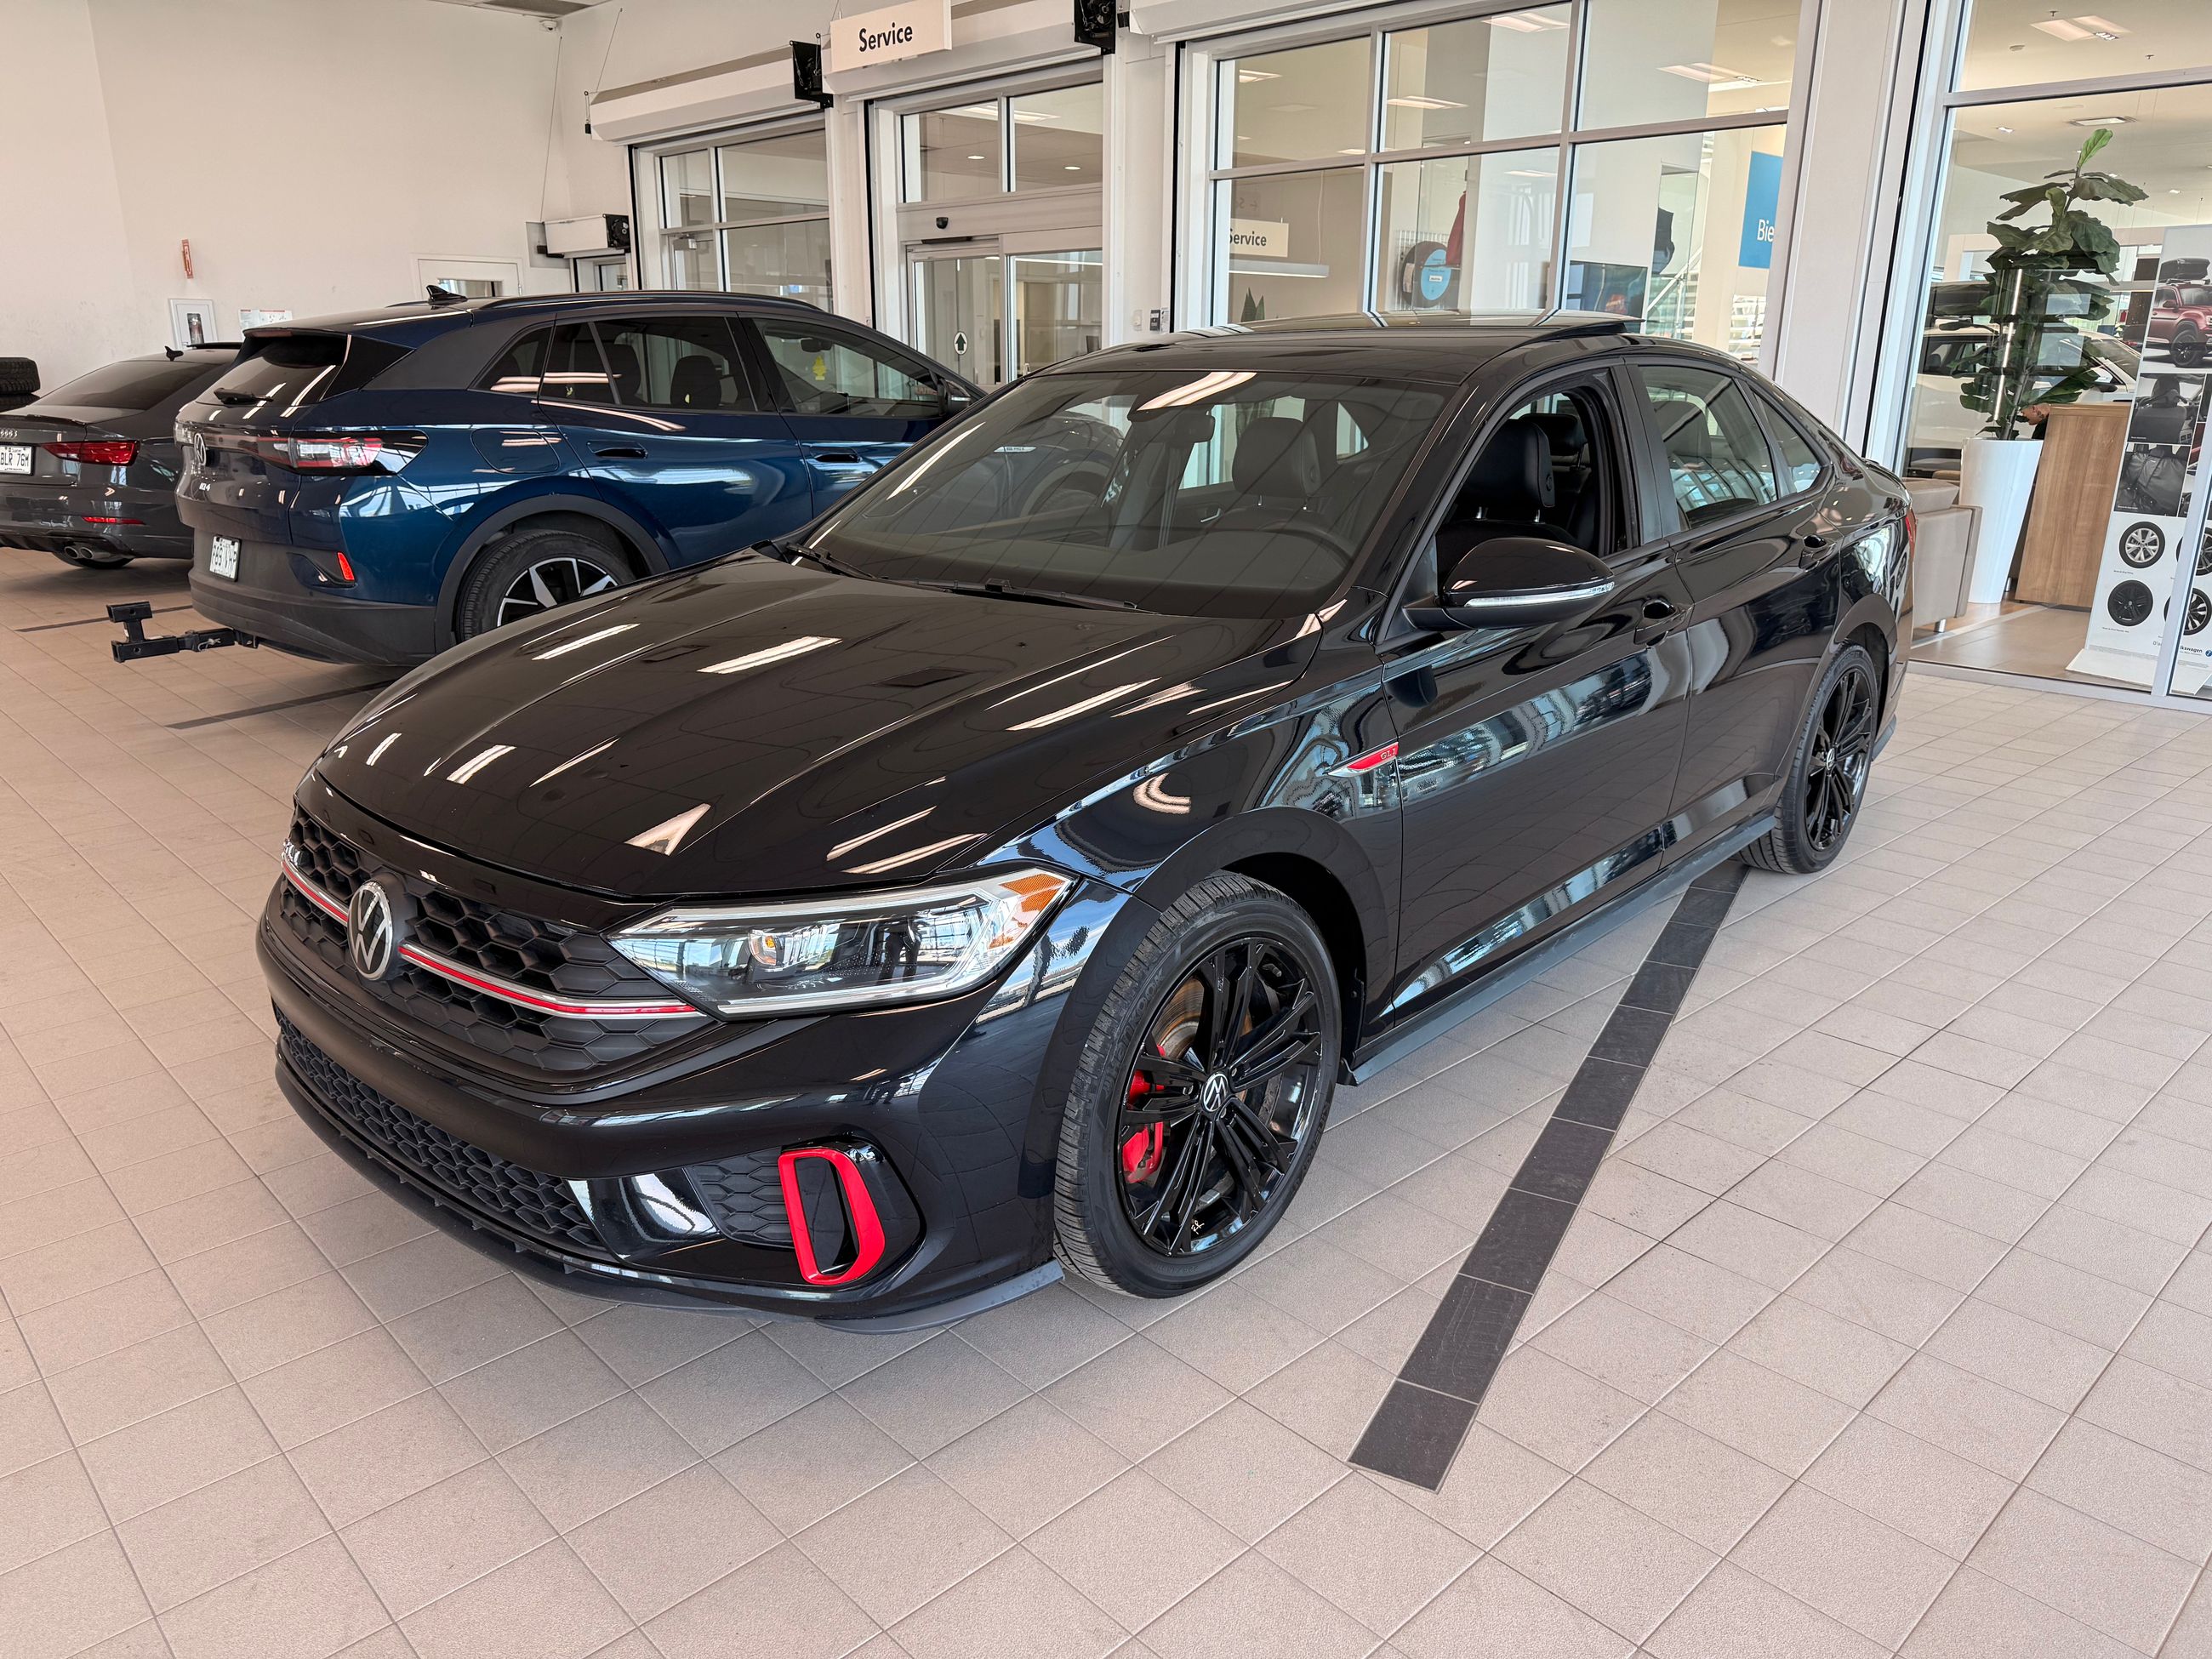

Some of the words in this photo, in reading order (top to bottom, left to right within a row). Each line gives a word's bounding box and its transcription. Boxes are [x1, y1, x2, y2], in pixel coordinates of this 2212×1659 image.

[858, 21, 913, 52] Service
[1757, 219, 1775, 242] Bie
[0, 452, 13, 466] BLR
[1380, 748, 1396, 760] GLI
